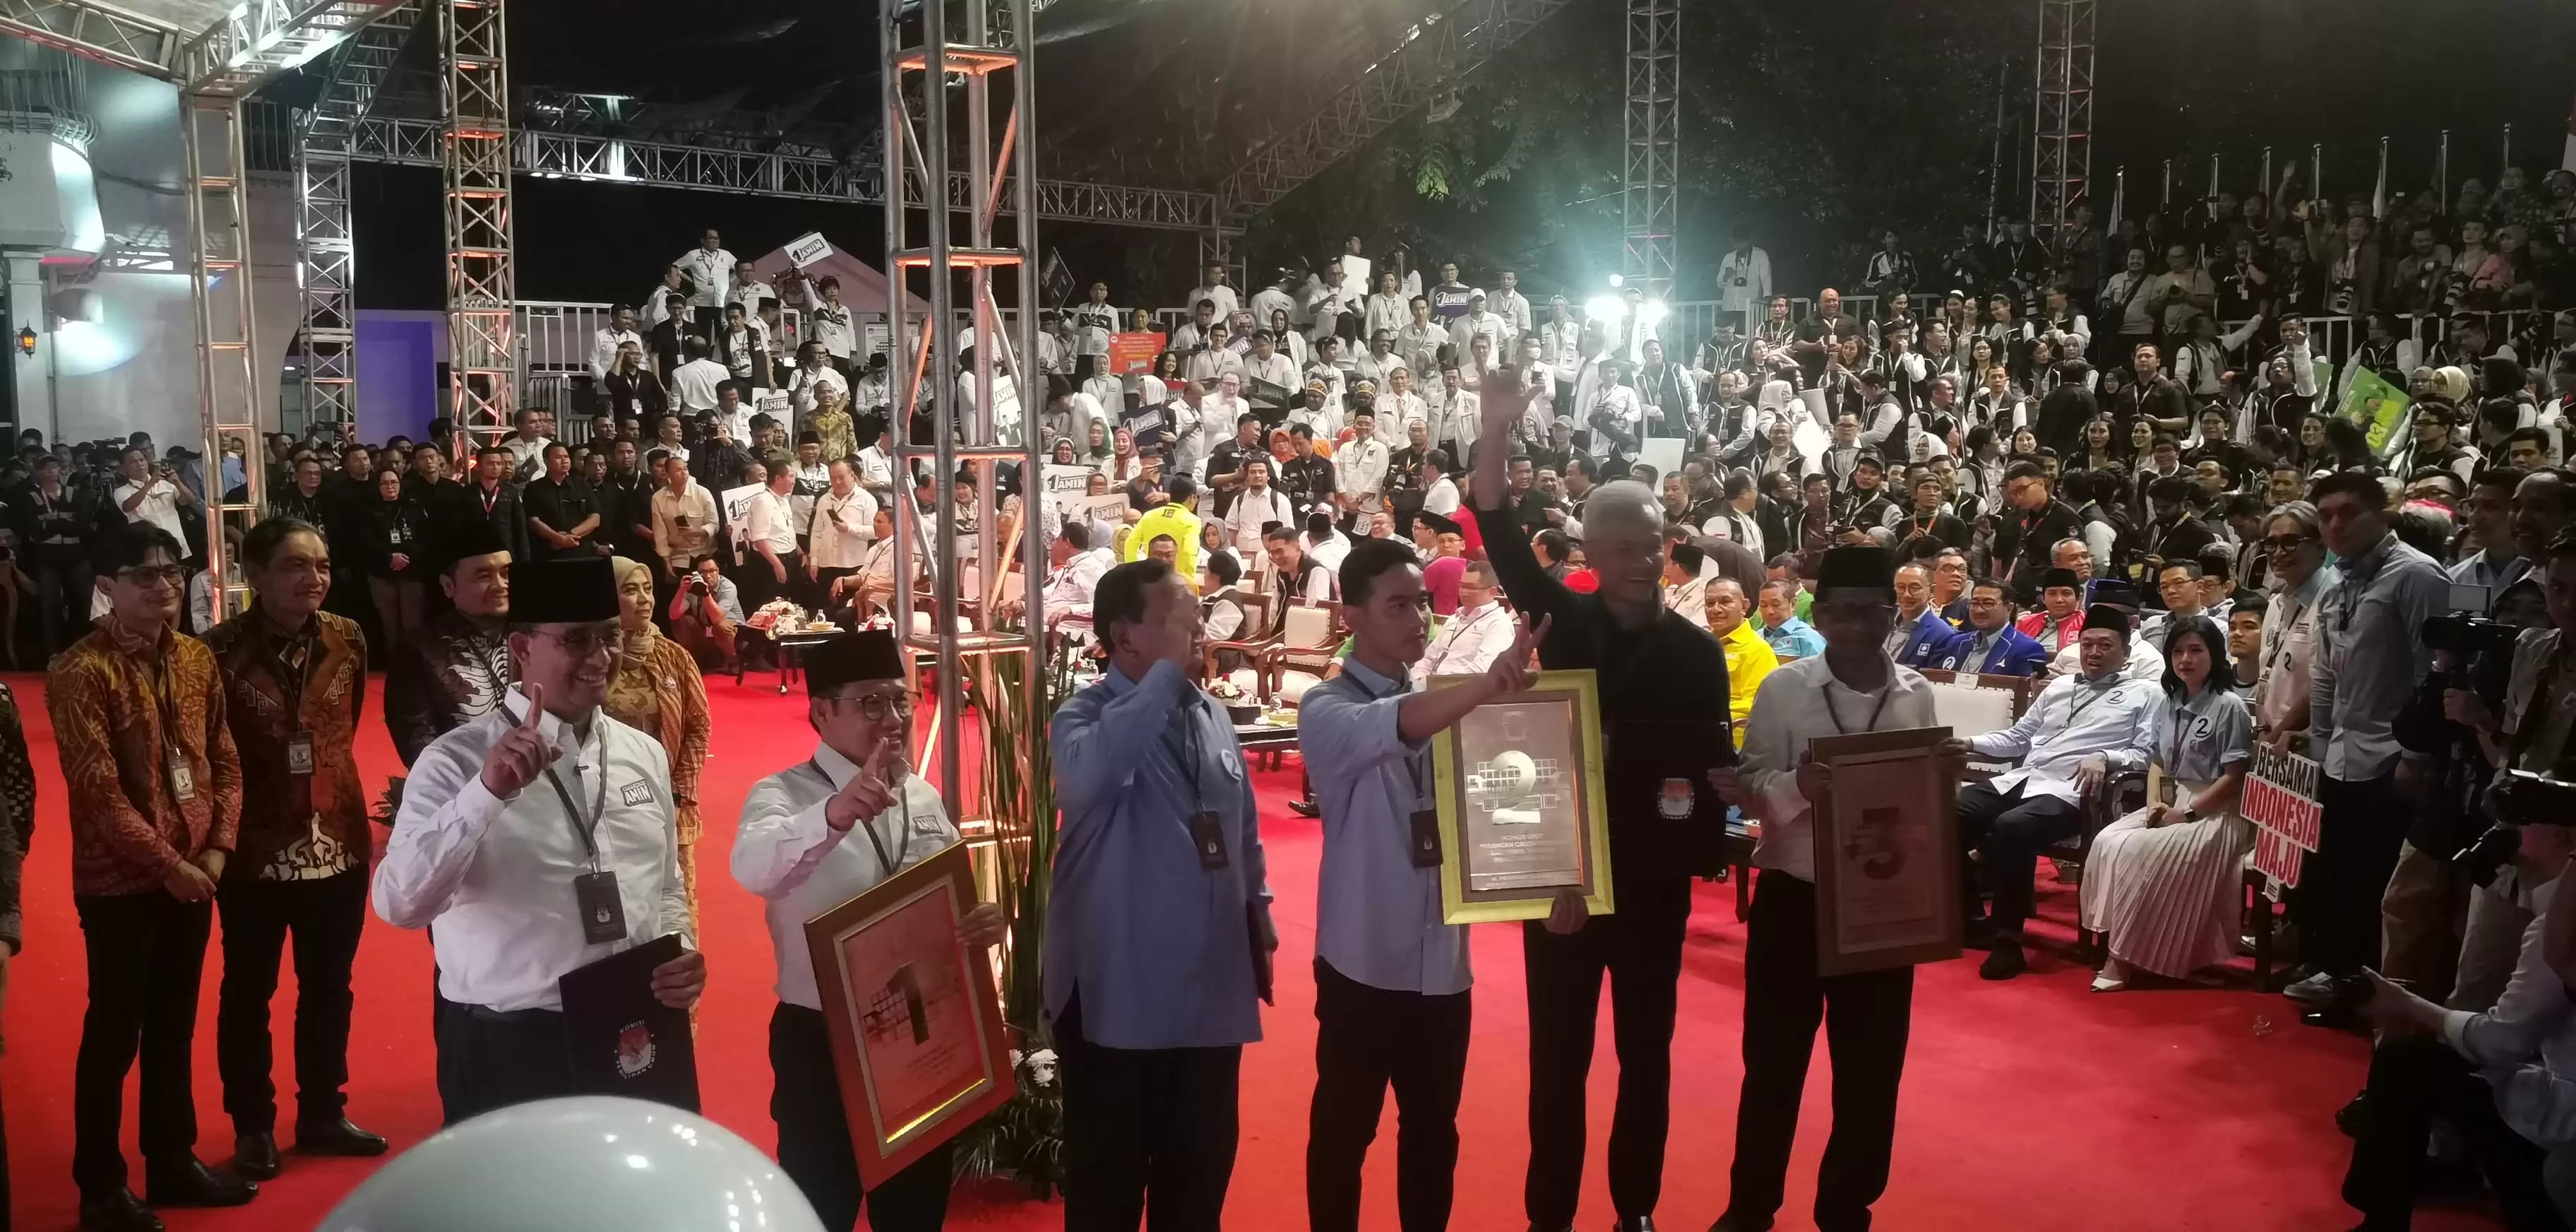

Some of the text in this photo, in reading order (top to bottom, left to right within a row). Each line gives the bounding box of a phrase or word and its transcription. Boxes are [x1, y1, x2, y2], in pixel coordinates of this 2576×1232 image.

[2196, 718, 2209, 735] 2
[624, 785, 651, 805] AMIN
[2257, 745, 2316, 799] BERSAMA
[2241, 776, 2321, 849] INDONESIA
[2254, 828, 2301, 886] MAJU
